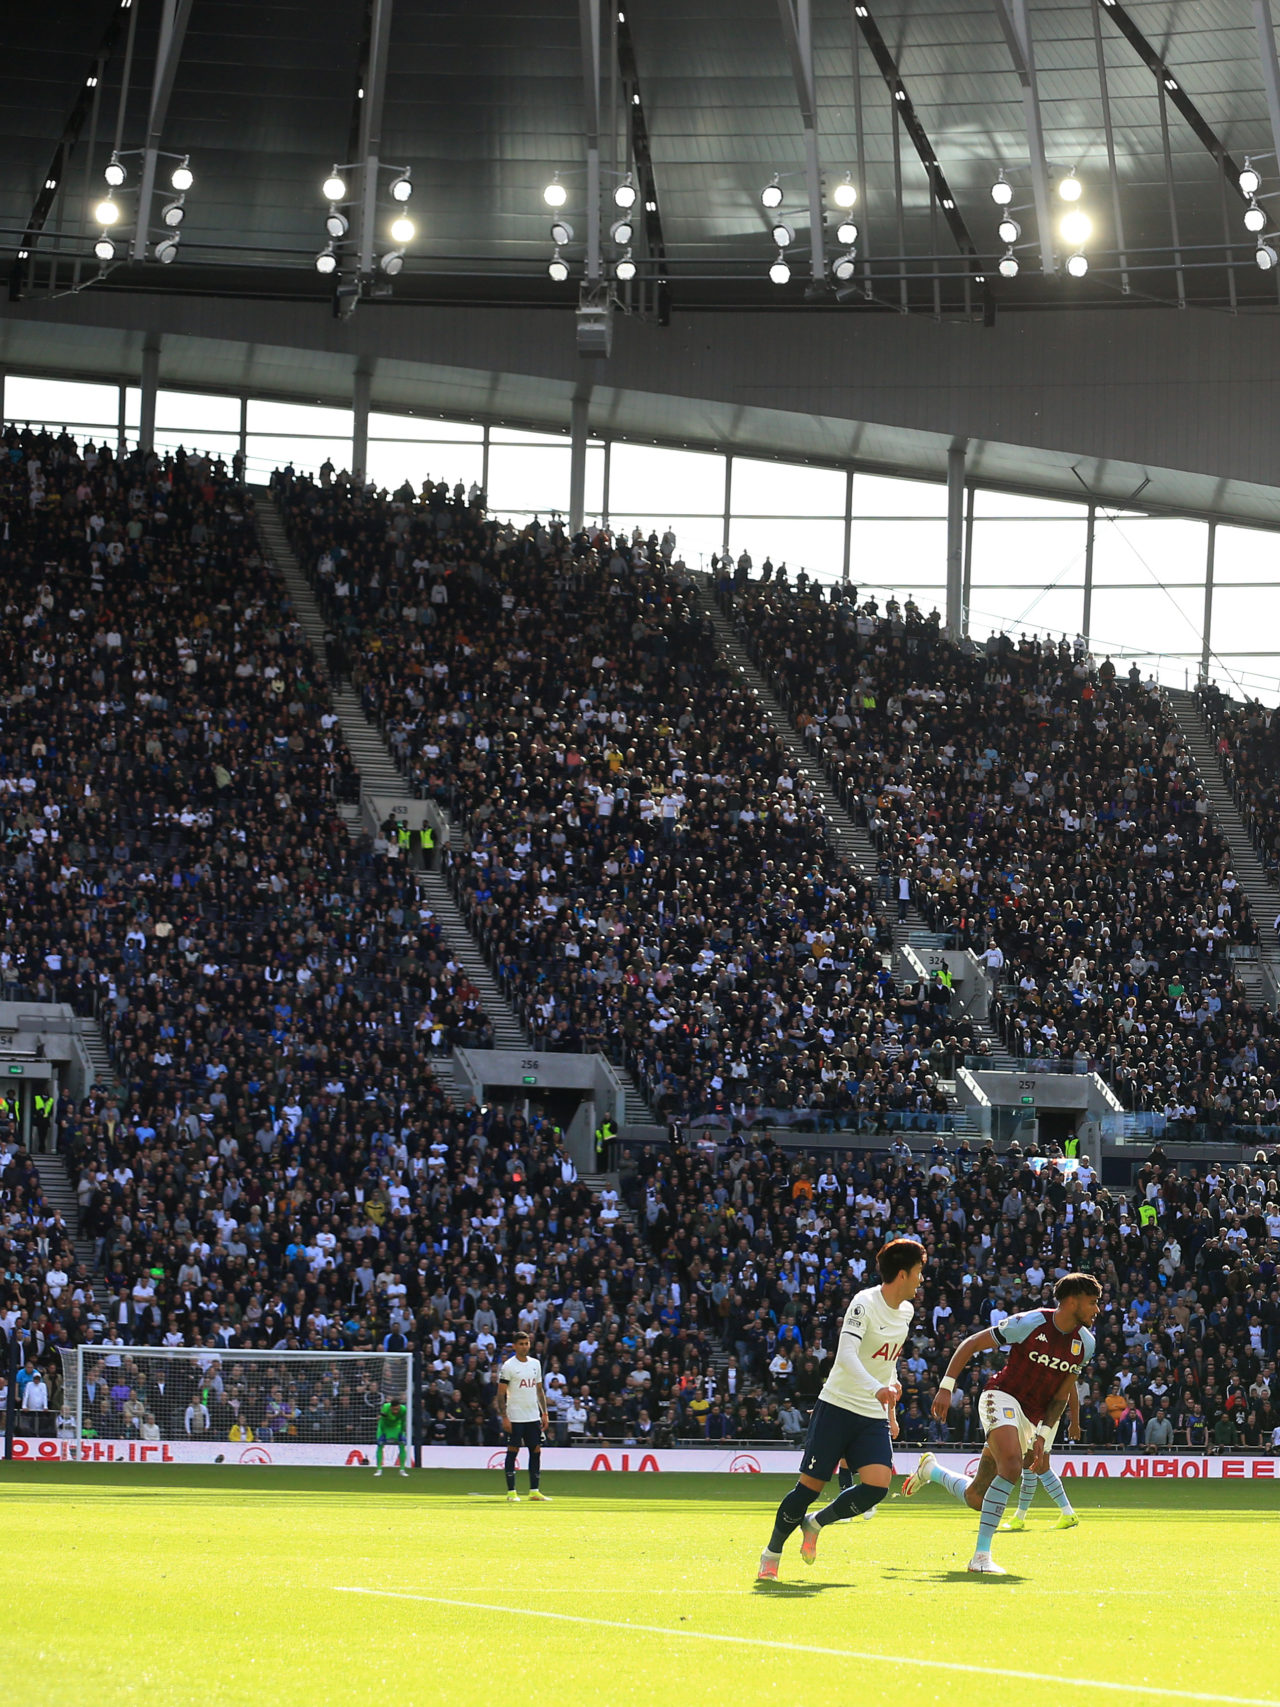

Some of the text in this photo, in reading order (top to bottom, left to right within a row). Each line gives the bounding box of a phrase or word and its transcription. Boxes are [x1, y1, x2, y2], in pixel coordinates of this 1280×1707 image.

[521, 1060, 539, 1069] 256
[1019, 1080, 1036, 1090] 257
[519, 1378, 536, 1388] AIA
[591, 1453, 660, 1472] AIA
